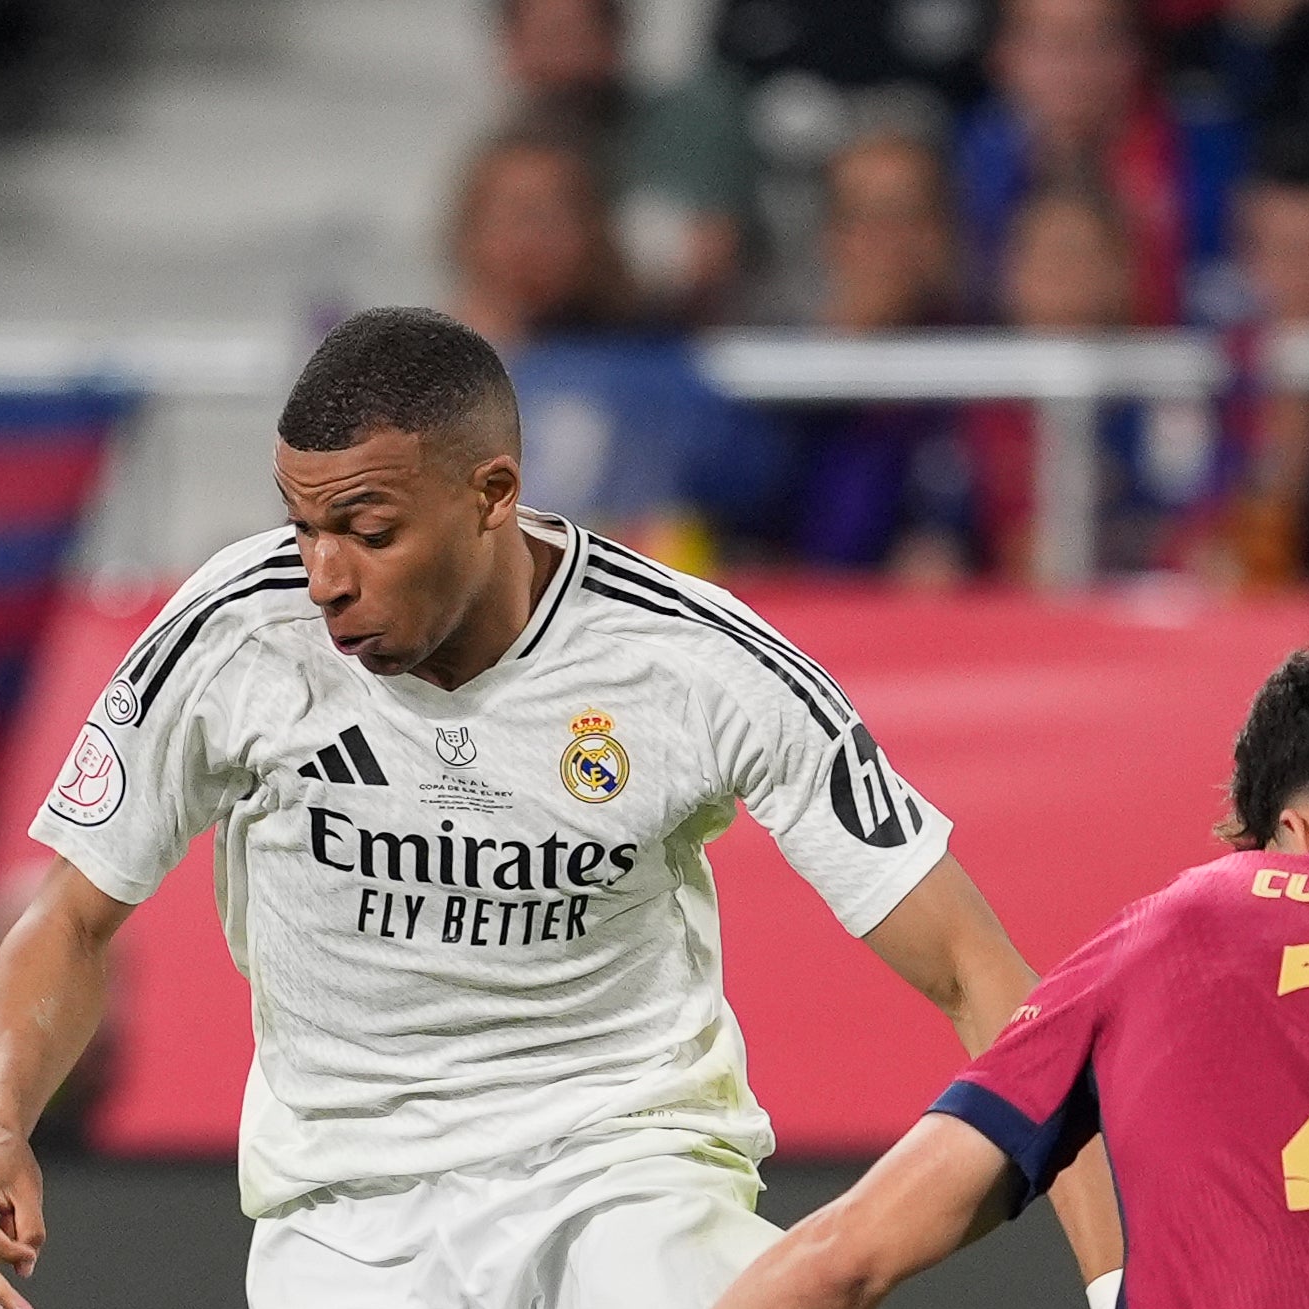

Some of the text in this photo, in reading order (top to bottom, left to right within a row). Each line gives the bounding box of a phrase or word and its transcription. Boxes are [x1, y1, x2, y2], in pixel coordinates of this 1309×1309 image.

[110, 689, 131, 715] 20
[307, 806, 638, 891] Emirates
[358, 888, 589, 946] FLY BETTER
